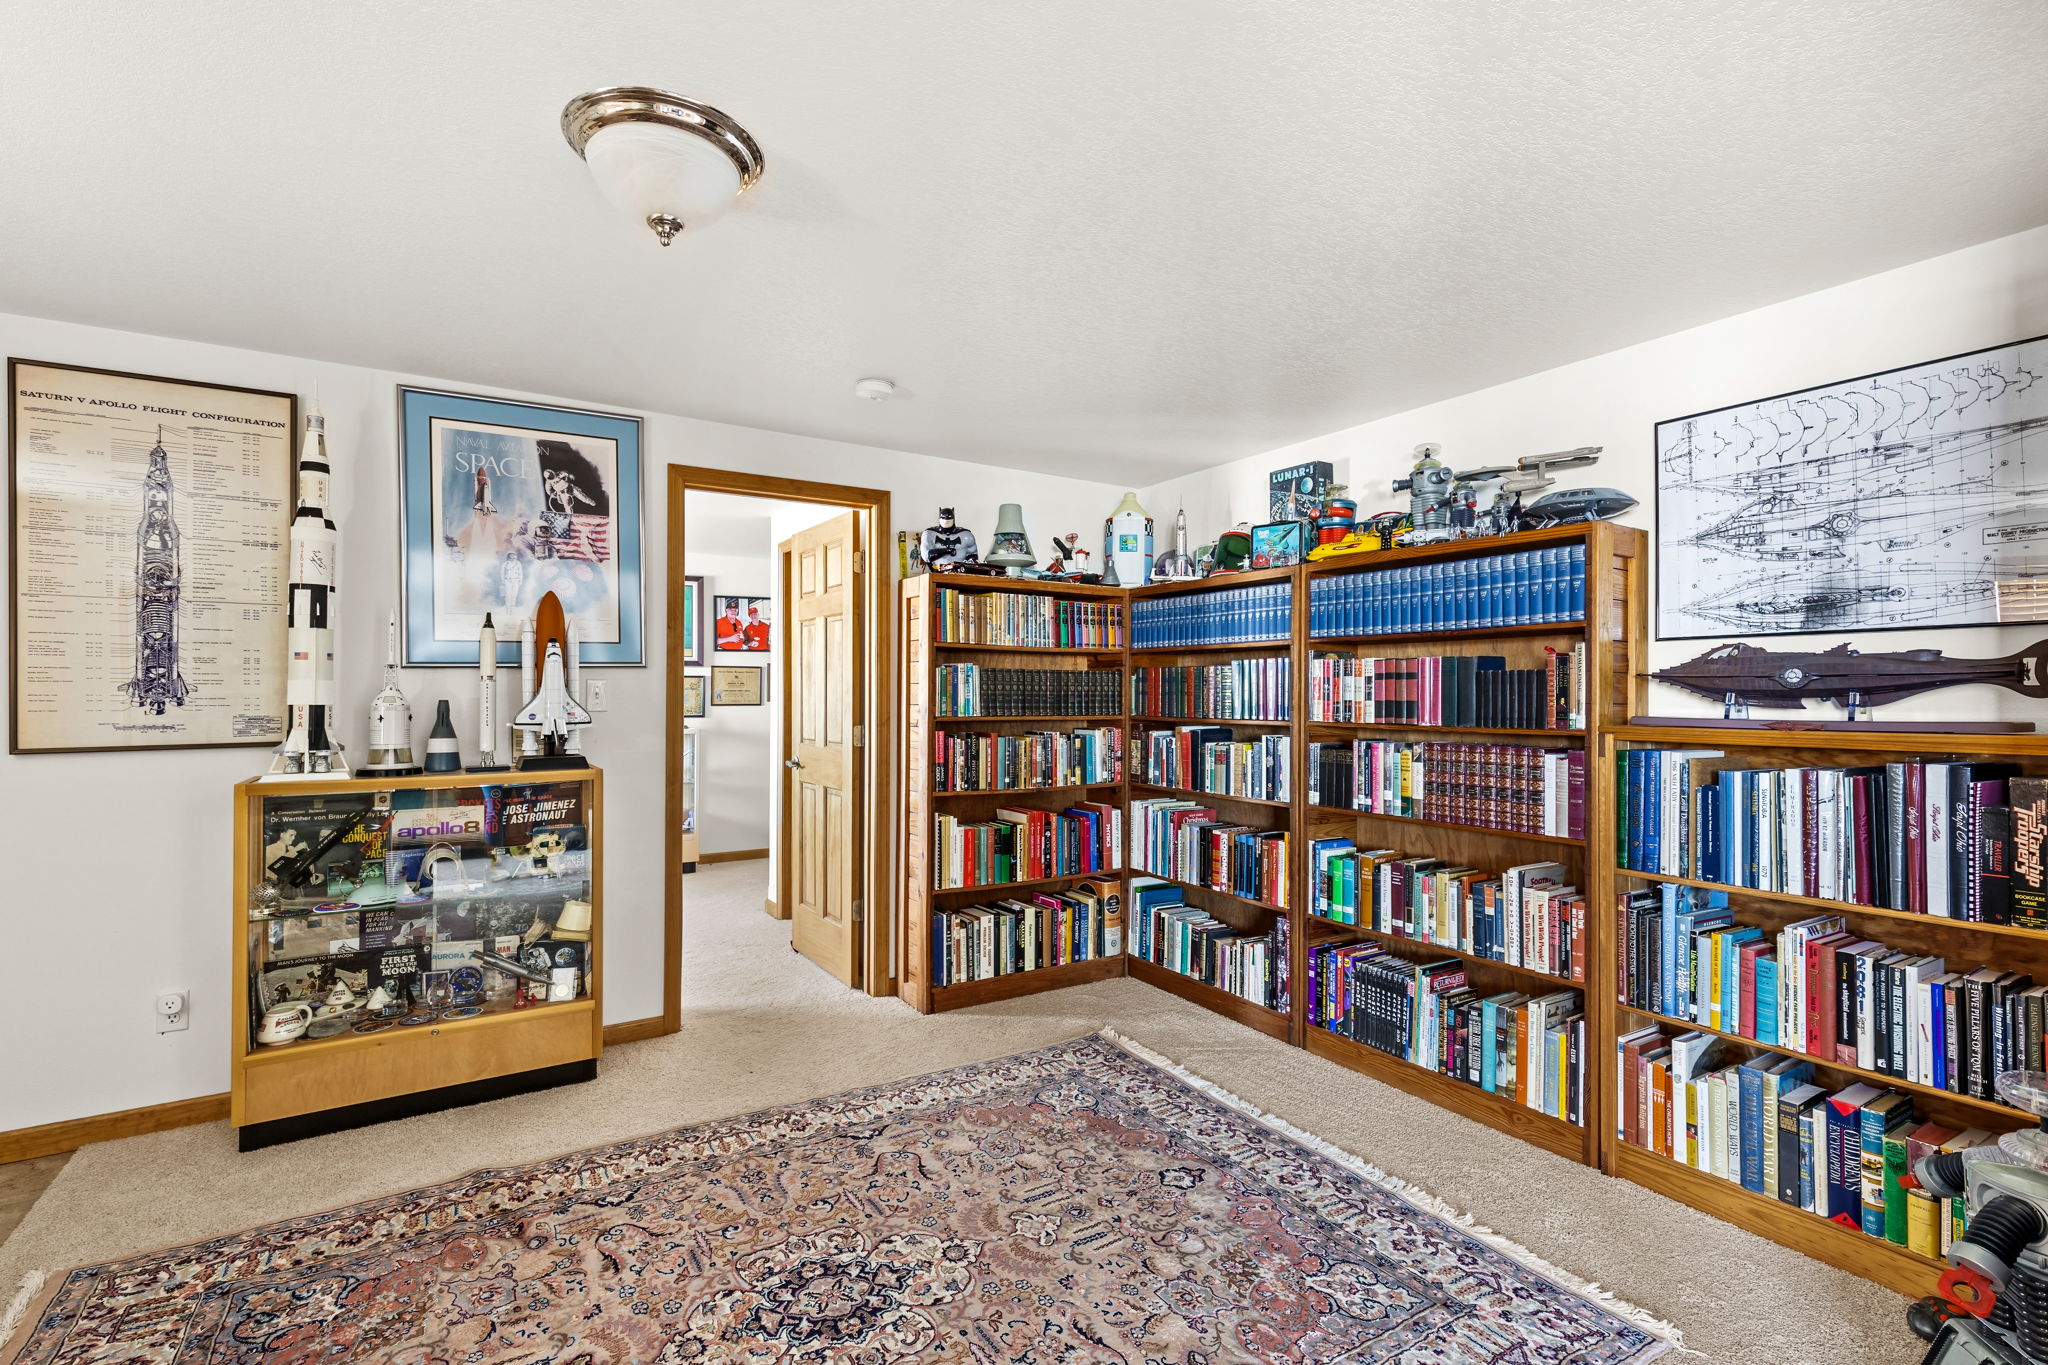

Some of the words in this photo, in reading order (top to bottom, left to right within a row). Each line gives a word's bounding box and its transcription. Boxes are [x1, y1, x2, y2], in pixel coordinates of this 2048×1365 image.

[19, 389, 73, 403] SATURN
[77, 397, 85, 405] V
[89, 398, 137, 410] APOLLO
[143, 405, 188, 417] FLIGHT
[192, 411, 286, 429] CONFIGURATION
[456, 435, 489, 449] NAVAL
[455, 451, 535, 480] SPACE
[503, 803, 528, 815] JOSE
[533, 799, 576, 812] JIMENEZ
[1680, 794, 1688, 811] Loyal
[510, 809, 568, 824] ASTRONAUT
[1930, 803, 1941, 826] Script
[1951, 802, 1967, 829] Script
[397, 822, 464, 838] apollo
[1680, 812, 1688, 843] Daughters
[1931, 826, 1941, 843] Ohio
[2013, 803, 2036, 874] Troopers
[371, 841, 382, 850] OF
[1955, 830, 1967, 853] Ohio
[1993, 840, 2003, 872] TRAVELLER
[2025, 824, 2048, 888] Starship
[2014, 893, 2047, 902] BOOKCASE
[1549, 900, 1560, 946] BUCKEYE
[1617, 917, 1626, 966] SKYWATCHING
[1665, 932, 1671, 942] OF
[381, 955, 416, 965] FIRST
[496, 945, 511, 953] MAN
[1677, 935, 1687, 963] Glencoe
[381, 966, 416, 976] MOON
[1841, 989, 1850, 1012] skeptical
[1892, 985, 1902, 998] THE
[1970, 990, 1981, 1008] FIVE
[1893, 997, 1903, 1025] ELECTRIC
[1993, 1007, 2004, 1038] Winning
[2030, 1003, 2039, 1031] LEADING
[1472, 1021, 1481, 1034] STAR
[1971, 1008, 1981, 1040] PILLARS
[1473, 1034, 1481, 1047] TREK
[1893, 1025, 1903, 1054] WISHING
[1972, 1041, 1981, 1051] OF
[1996, 1042, 2004, 1050] in
[2031, 1031, 2039, 1044] with
[1472, 1047, 1481, 1070] CREATOR
[1893, 1054, 1904, 1071] WELL
[1972, 1053, 1981, 1071] TQM
[2031, 1044, 2040, 1067] HONOR
[1638, 1075, 1646, 1103] Egyptian
[1639, 1104, 1647, 1129] Religion
[1729, 1100, 1738, 1131] WORLD
[1745, 1094, 1758, 1119] THE
[1763, 1095, 1775, 1144] WORLD
[1730, 1134, 1738, 1157] WAYS
[1745, 1122, 1759, 1154] CIVIL
[1764, 1144, 1775, 1177] WAR
[1829, 1124, 1841, 1185] ENCYCLOPEDIA
[1844, 1129, 1862, 1192] CHILDREN'S
[1746, 1155, 1759, 1182] WAR
